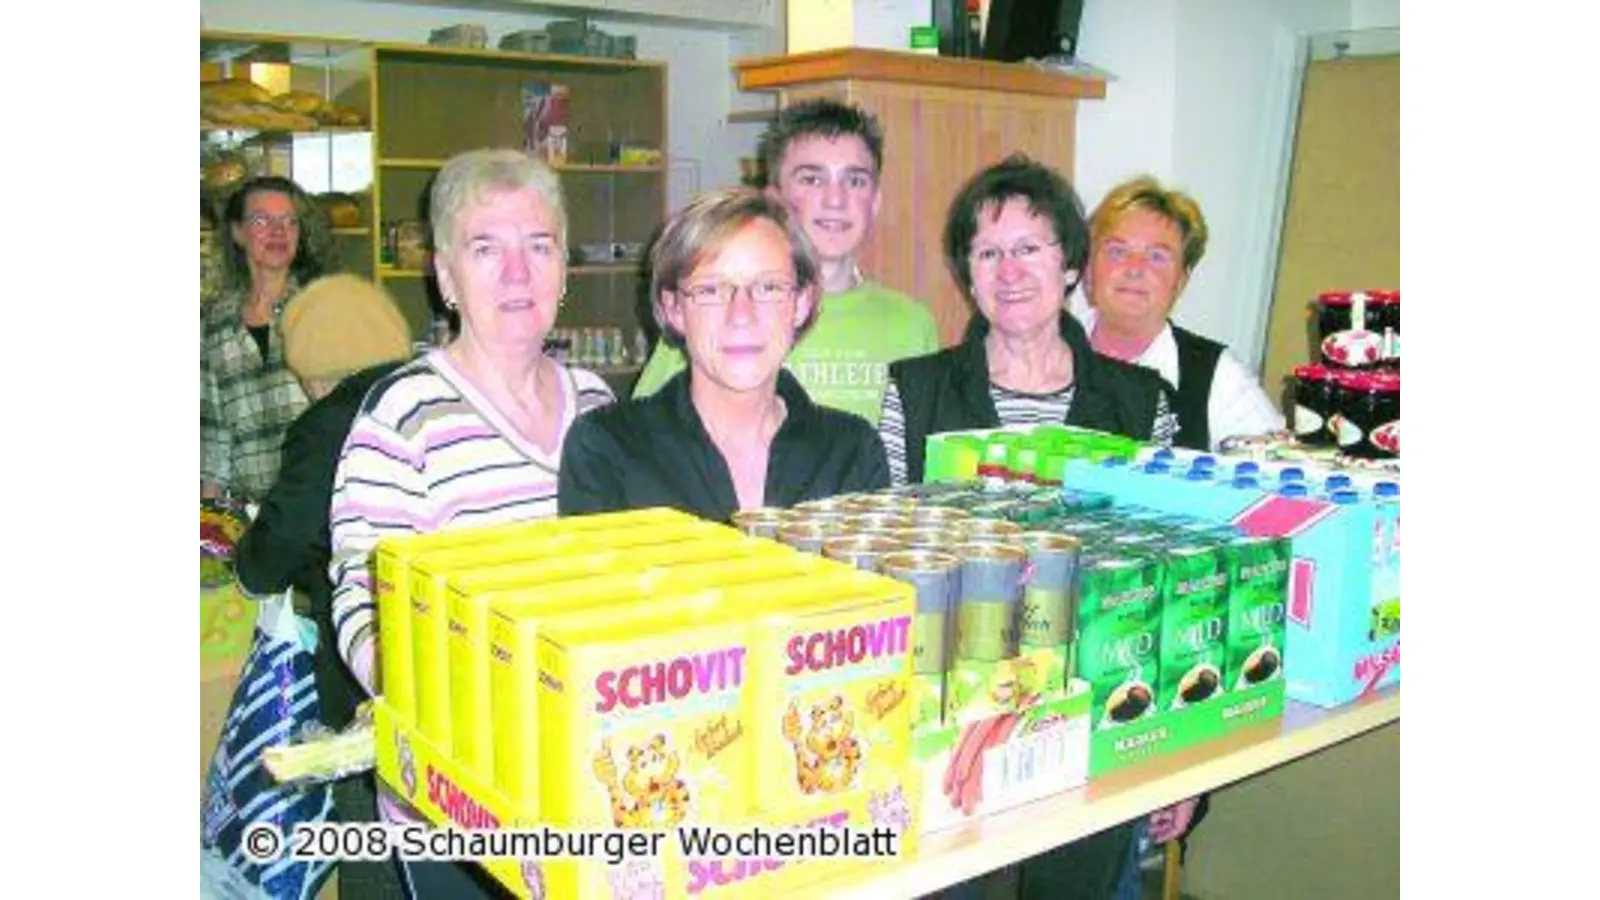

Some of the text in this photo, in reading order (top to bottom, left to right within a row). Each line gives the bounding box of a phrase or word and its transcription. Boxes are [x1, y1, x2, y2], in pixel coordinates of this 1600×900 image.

[796, 362, 888, 384] THLETE
[784, 616, 911, 675] SCHOVIT
[595, 647, 746, 713] SCHOVIT
